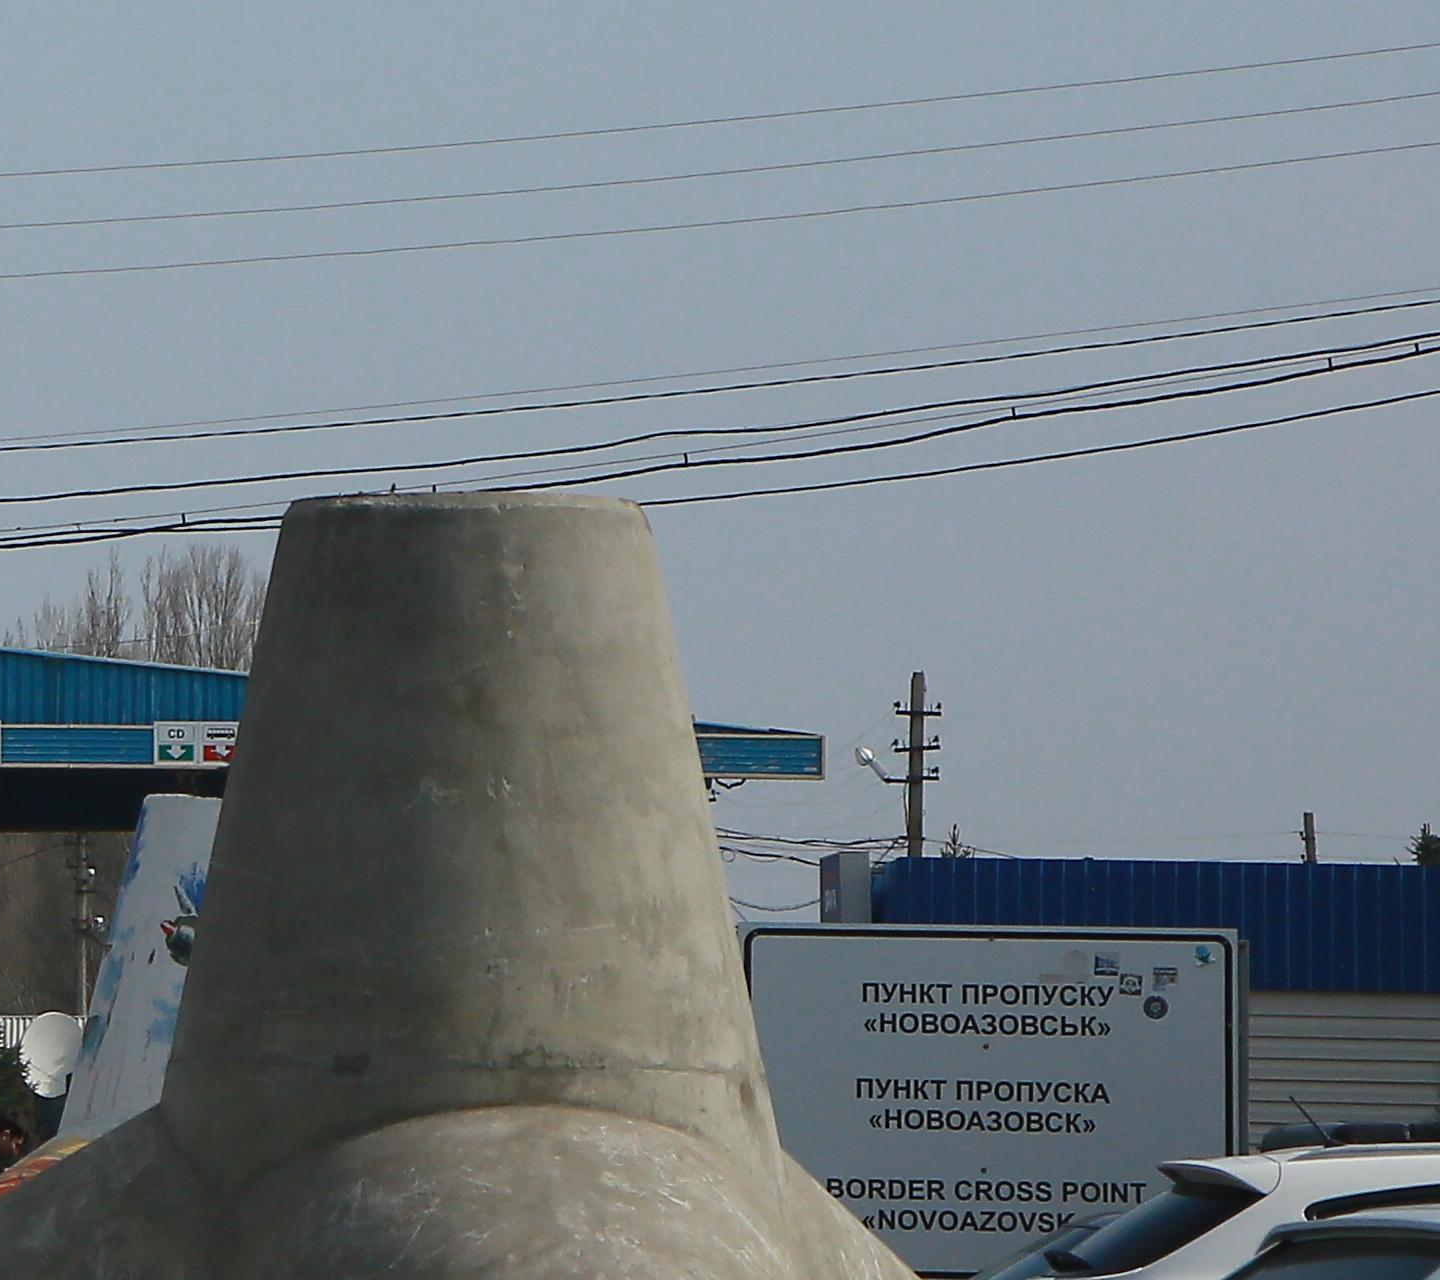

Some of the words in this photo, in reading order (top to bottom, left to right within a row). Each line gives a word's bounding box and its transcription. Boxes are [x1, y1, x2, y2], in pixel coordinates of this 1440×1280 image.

[168, 728, 186, 739] CD
[861, 983, 952, 1004] ПУНКТ
[961, 984, 1114, 1007] ПРОПУСКУ
[863, 1013, 1112, 1037] «НОВОАЗОВСЬК»
[855, 1078, 947, 1100] ПУНКТ
[956, 1080, 1111, 1104] ПРОПУСКА
[869, 1109, 1096, 1133] «НОВОАЗОВСК»
[826, 1179, 945, 1200] BORDER
[954, 1180, 1052, 1203] CROSS
[1062, 1182, 1147, 1204] POINT
